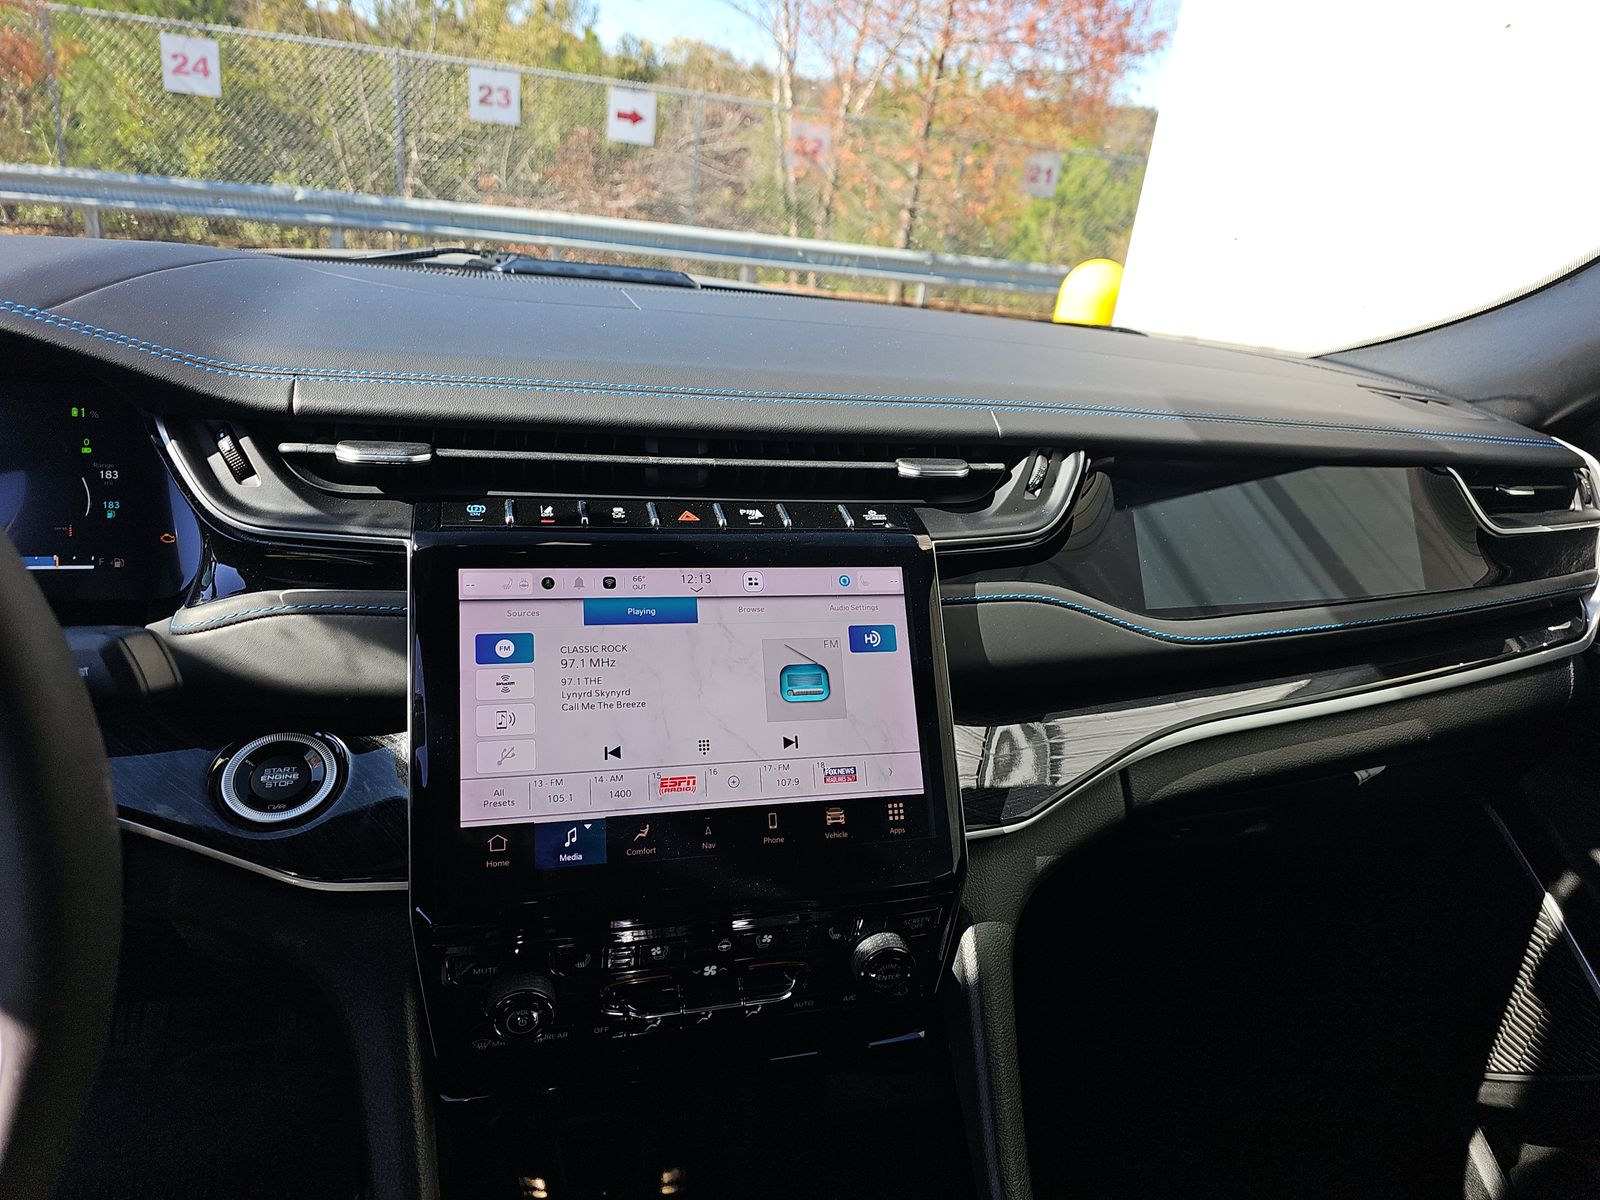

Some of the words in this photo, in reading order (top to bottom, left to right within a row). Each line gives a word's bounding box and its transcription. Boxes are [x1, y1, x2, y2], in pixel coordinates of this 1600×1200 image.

[170, 52, 211, 79] 24
[478, 83, 512, 108] 23
[1028, 166, 1054, 185] 21
[100, 470, 119, 480] 183
[102, 500, 120, 509] 183
[680, 574, 712, 585] 12:13
[632, 583, 647, 591] OUT
[627, 607, 656, 617] Playing
[829, 603, 850, 611] Audio
[850, 603, 879, 613] Settings
[506, 609, 540, 618] Sources
[498, 644, 512, 653] FM
[560, 644, 599, 655] CLASSIC
[601, 643, 628, 653] ROCK
[823, 639, 839, 649] FM
[560, 657, 585, 669] 97.1
[589, 657, 617, 668] MHz
[561, 677, 582, 686] 97.1
[584, 676, 603, 685] THE
[561, 689, 592, 700] Lynyrd
[594, 688, 631, 699] Skynyrd
[561, 702, 580, 711] Call
[581, 701, 596, 710] Me
[598, 700, 614, 710] The
[616, 700, 646, 709] Breeze
[264, 766, 298, 774] START
[763, 764, 773, 772] 17
[777, 763, 790, 772] FM
[816, 761, 825, 769] 18
[260, 773, 300, 781] ENGINE
[652, 771, 662, 780] 15
[709, 768, 718, 776] 16
[265, 780, 294, 788] STOP
[533, 780, 543, 788] 13
[550, 778, 564, 787] FM
[594, 775, 604, 784] 14
[609, 774, 624, 783] AM
[659, 776, 697, 788] ESPN
[776, 777, 800, 787] 107.9
[493, 788, 505, 797] All
[609, 789, 632, 799] 1400
[663, 786, 691, 794] RADIO
[483, 798, 515, 808] Presets
[547, 793, 573, 803] 105.1
[825, 830, 848, 840] Vehicle
[889, 827, 906, 836] Apps
[763, 835, 785, 845] Phone
[702, 841, 716, 850] Nav
[626, 846, 656, 856] Comfort
[559, 852, 583, 862] Media
[486, 859, 510, 868] Home
[472, 966, 497, 976] MUTE
[793, 1000, 814, 1008] AUTO
[593, 1026, 609, 1034] OFF
